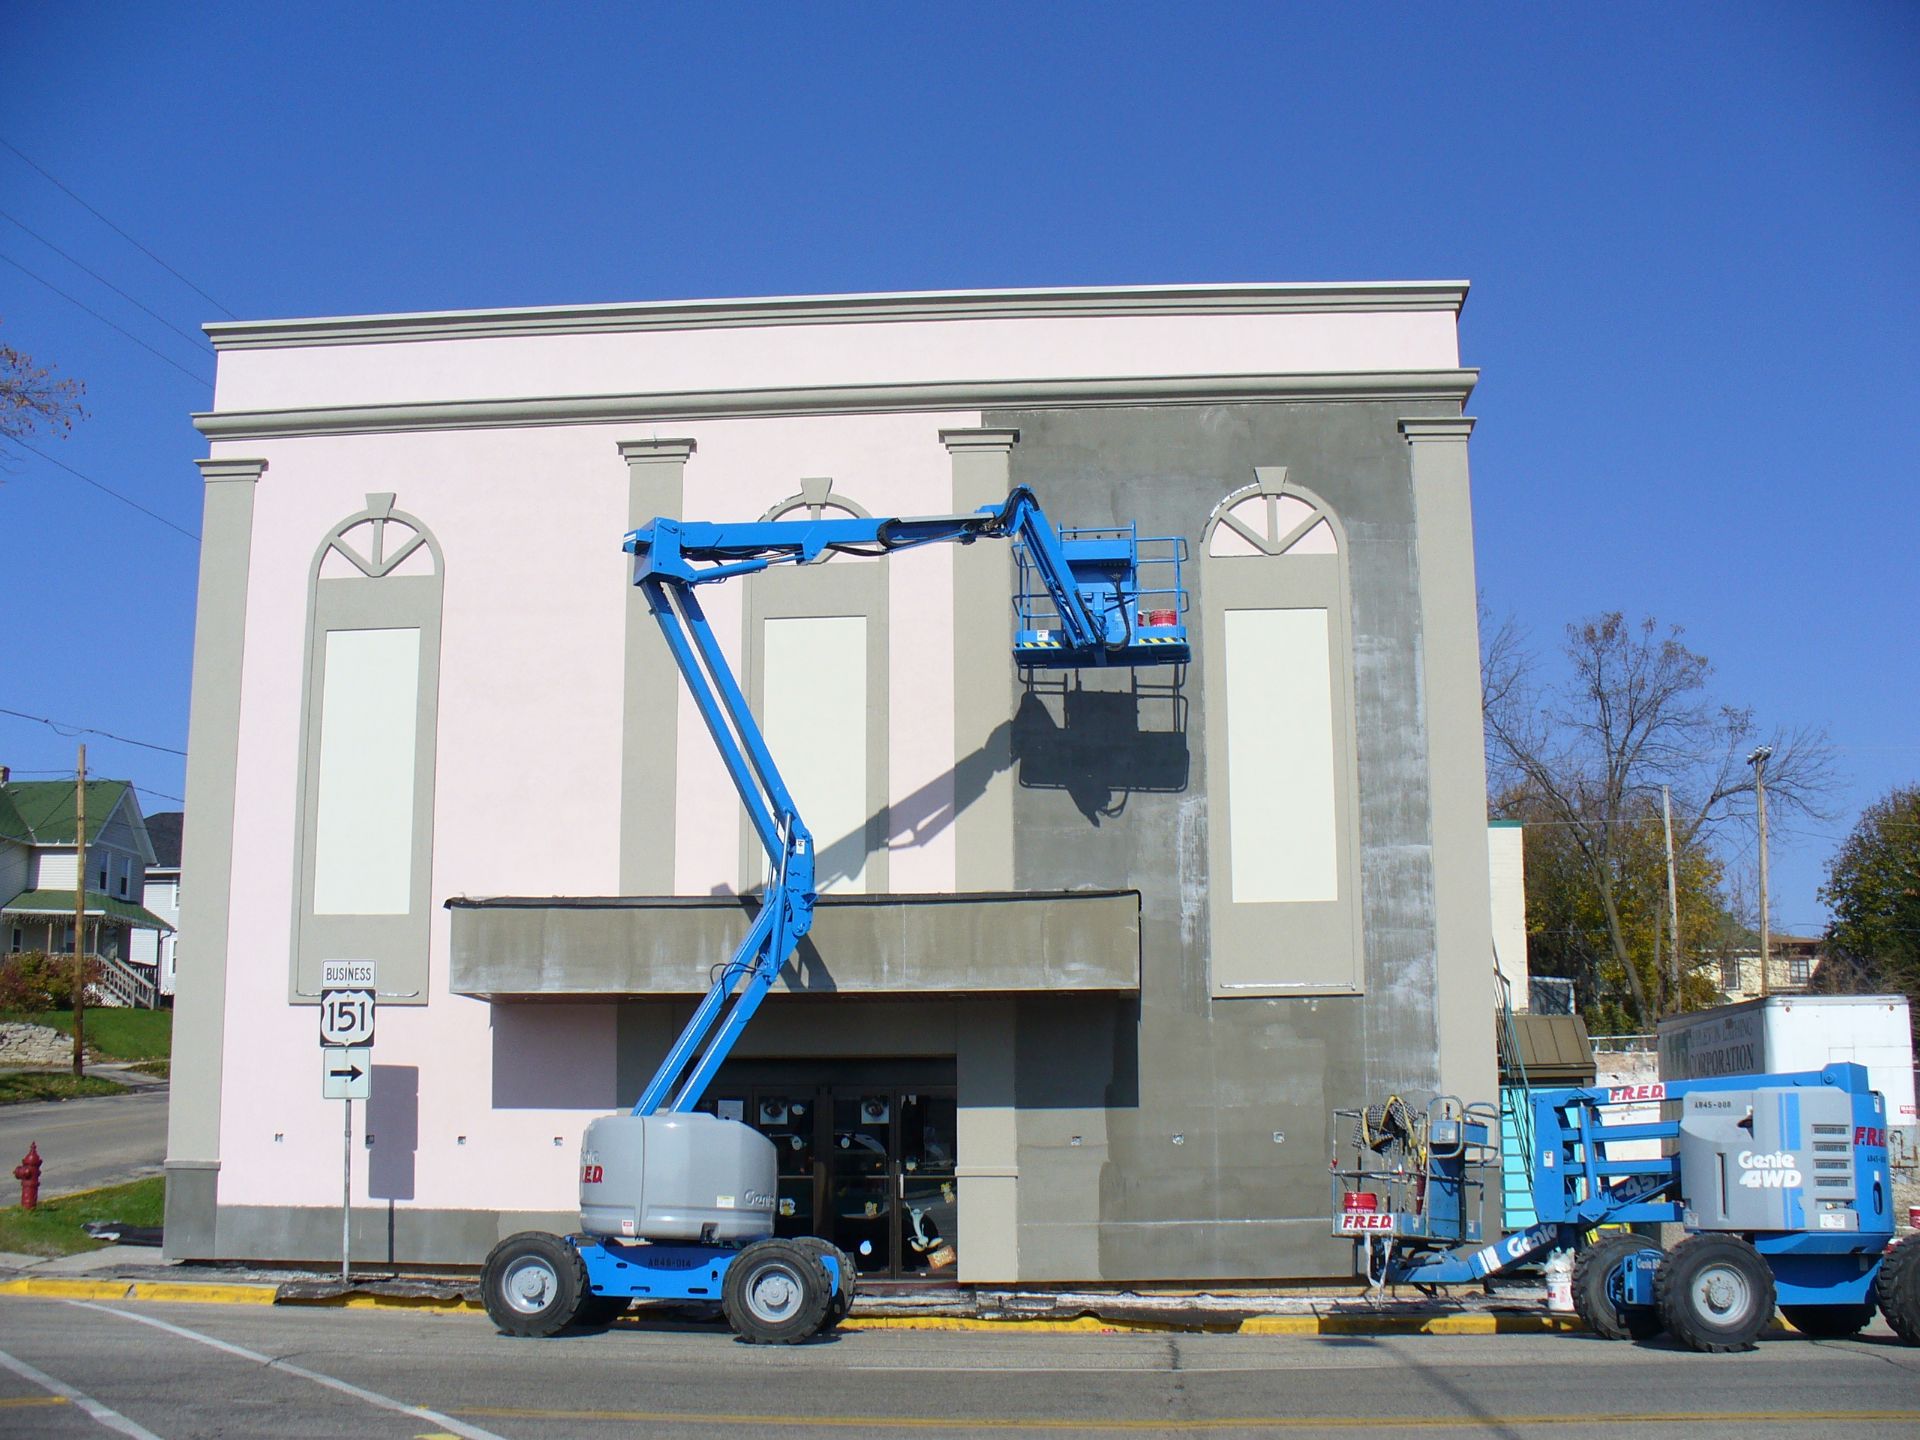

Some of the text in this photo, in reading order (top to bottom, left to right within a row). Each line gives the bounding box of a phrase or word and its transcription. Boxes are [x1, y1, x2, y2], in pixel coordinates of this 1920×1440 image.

[326, 967, 371, 981] BUSINESS
[328, 1001, 366, 1032] 151
[1690, 1043, 1754, 1077] CORPORATION
[1738, 1150, 1795, 1169] Genie
[1739, 1169, 1802, 1188] 4WD
